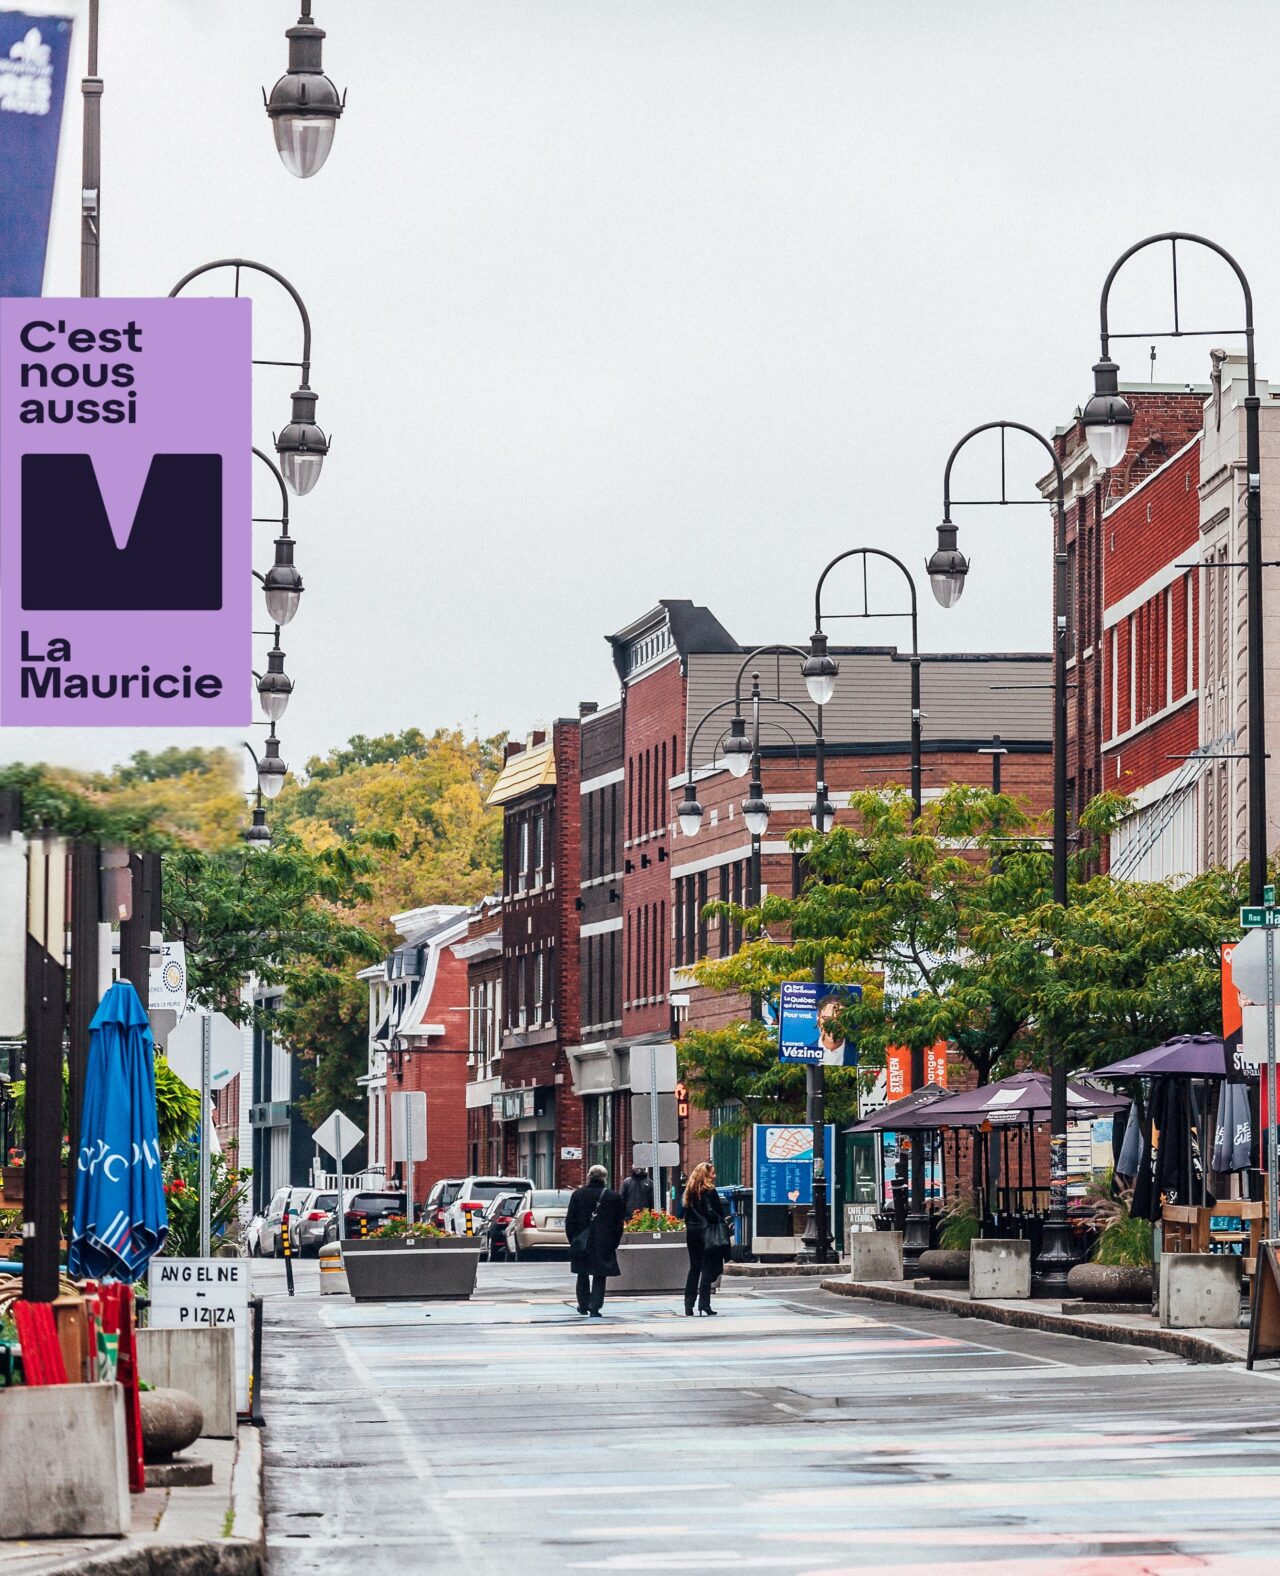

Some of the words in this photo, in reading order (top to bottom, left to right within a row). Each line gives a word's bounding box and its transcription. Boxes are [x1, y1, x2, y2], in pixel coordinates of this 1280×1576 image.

[20, 320, 143, 353] C'est
[20, 362, 135, 388] nous
[19, 390, 137, 424] aussi
[20, 630, 72, 662] La
[20, 665, 223, 699] Mauricie
[1248, 913, 1261, 922] Rue
[782, 1046, 823, 1058] Vézina
[889, 1057, 900, 1093] STEVEN
